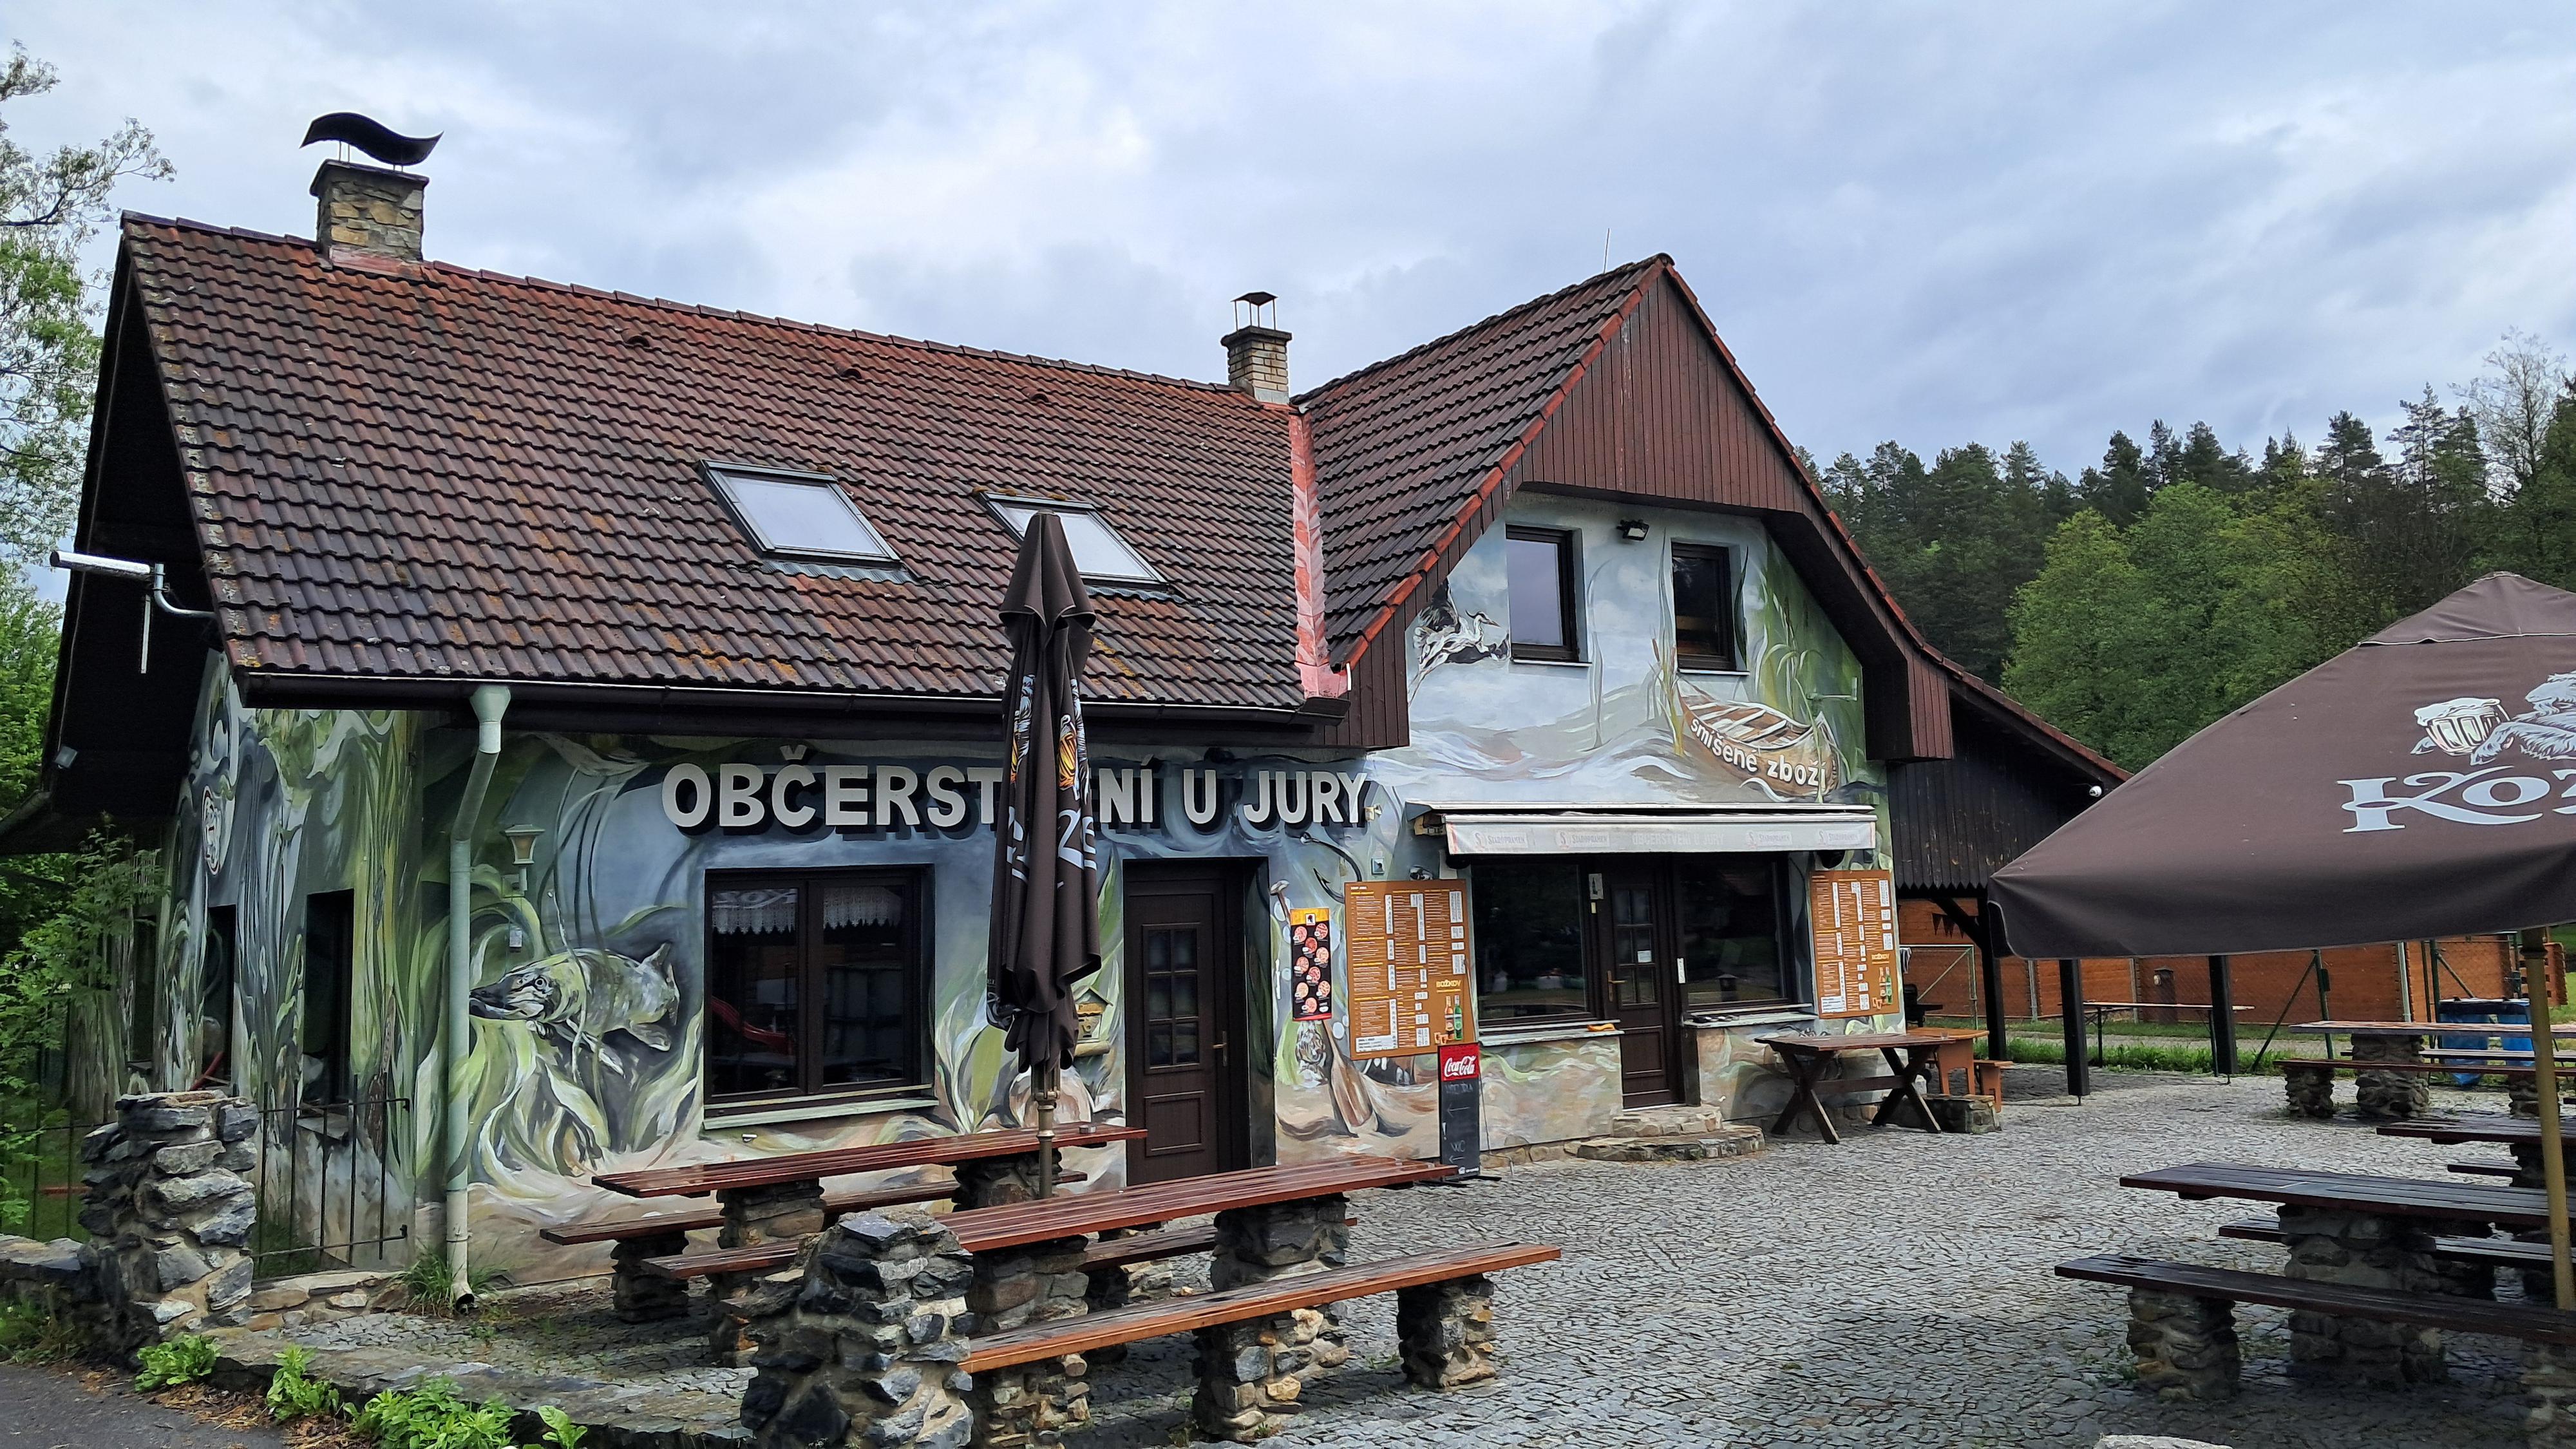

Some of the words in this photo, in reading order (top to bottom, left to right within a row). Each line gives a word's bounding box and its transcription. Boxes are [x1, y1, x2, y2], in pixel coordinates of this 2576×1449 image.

[661, 744, 1153, 828] OBČERSTNÍ
[1183, 769, 1217, 824] U
[1243, 770, 1368, 824] JURY
[1690, 718, 1758, 772] smíšené
[1766, 754, 1826, 788] zboží
[1450, 1139, 1466, 1153] WC
